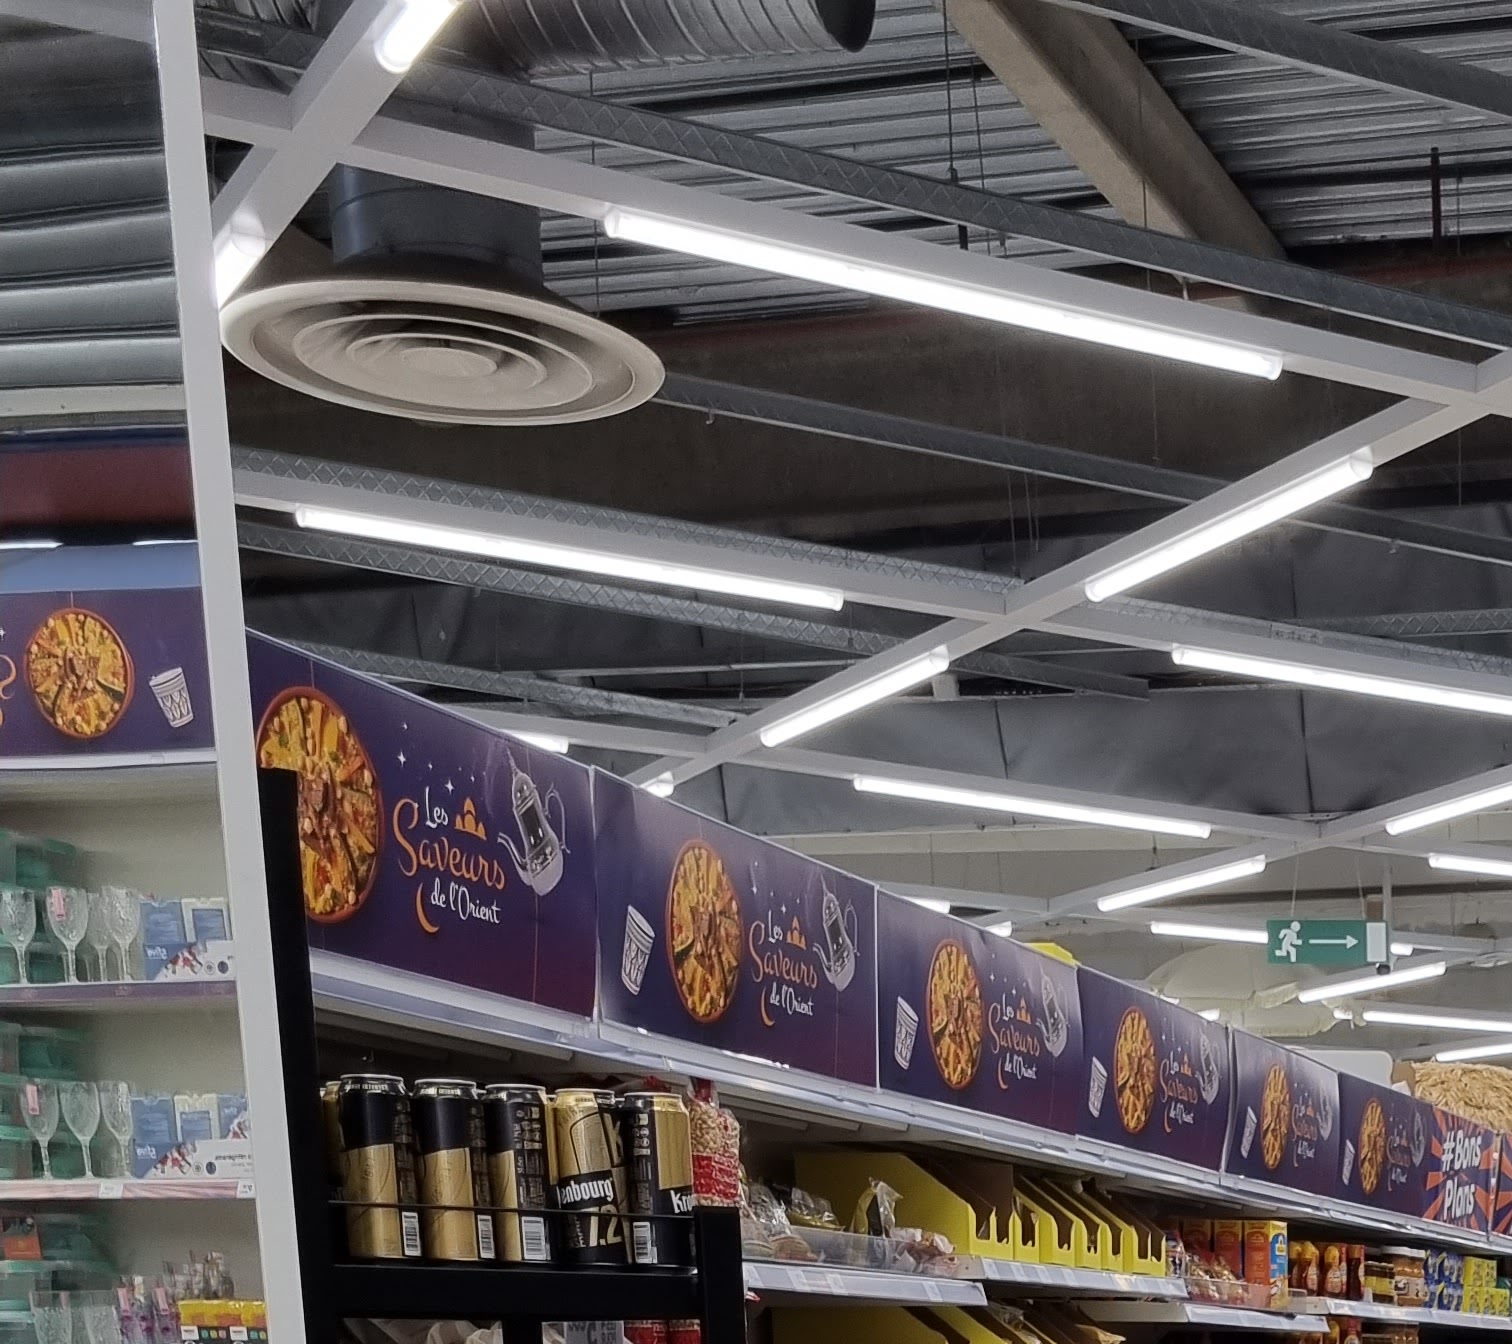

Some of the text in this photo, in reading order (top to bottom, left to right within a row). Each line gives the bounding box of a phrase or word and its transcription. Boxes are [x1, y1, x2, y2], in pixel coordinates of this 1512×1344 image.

[425, 786, 448, 829] Les
[393, 798, 505, 890] Saveurs
[1442, 1129, 1482, 1173] #Bons
[1443, 1175, 1476, 1220] Plans
